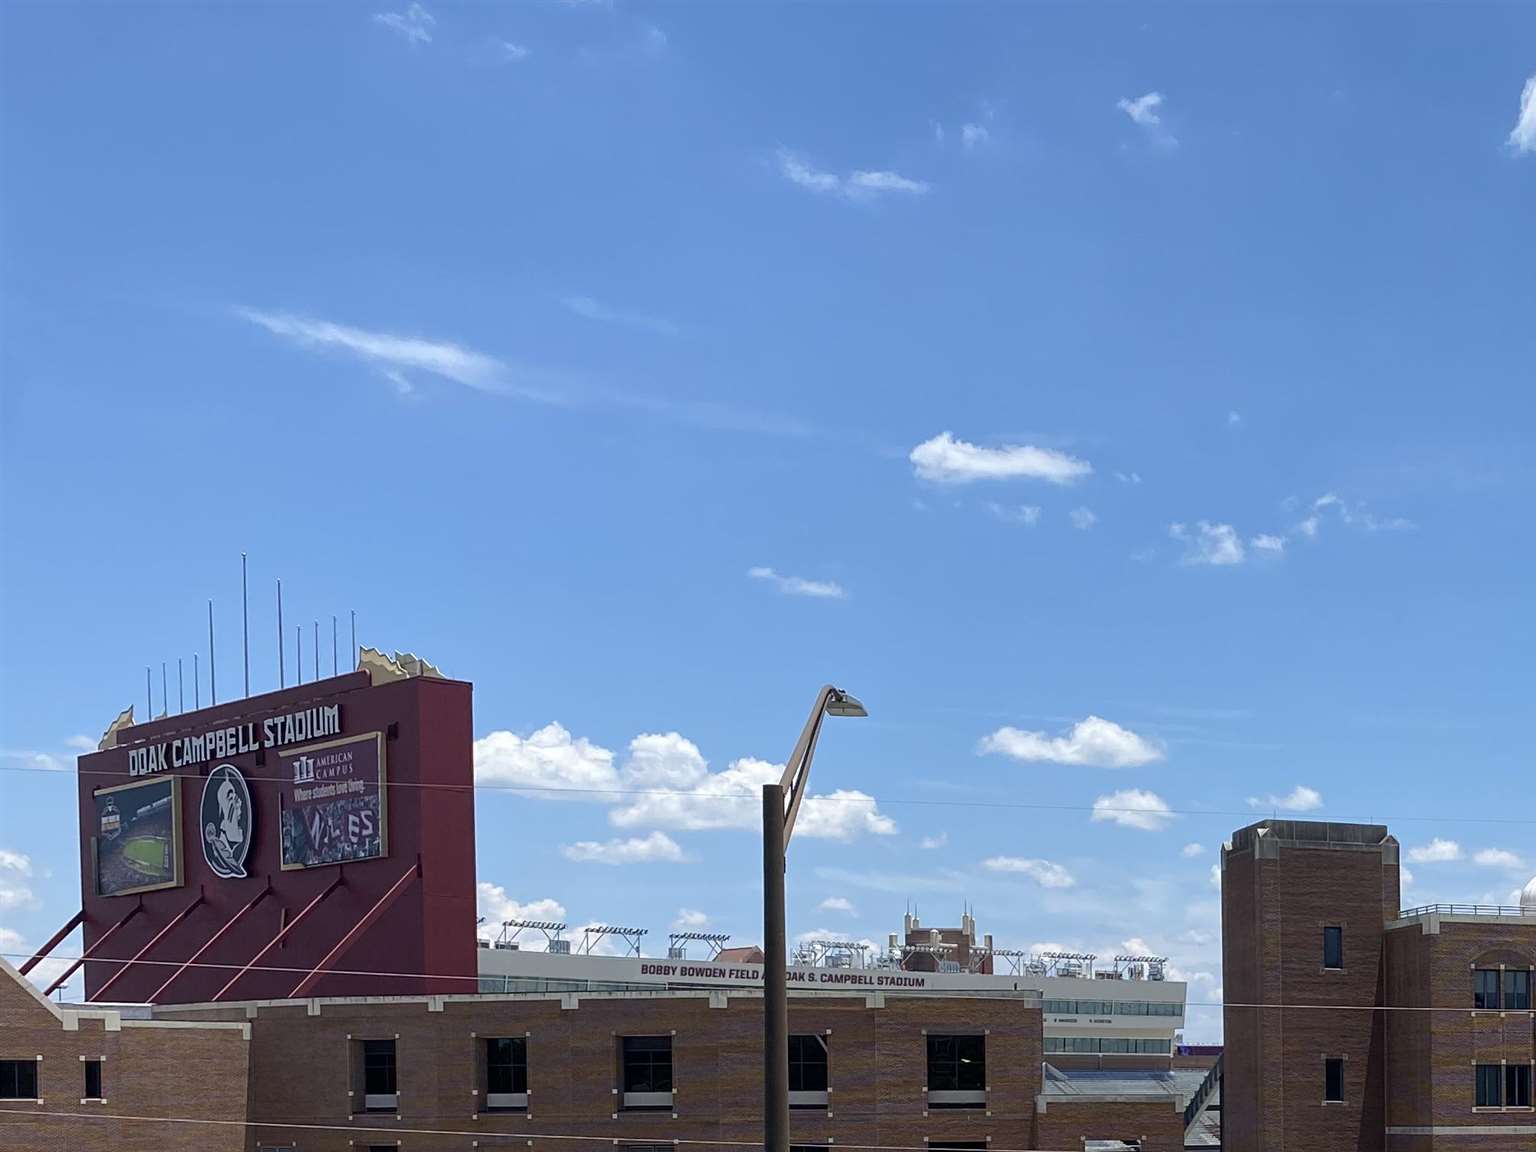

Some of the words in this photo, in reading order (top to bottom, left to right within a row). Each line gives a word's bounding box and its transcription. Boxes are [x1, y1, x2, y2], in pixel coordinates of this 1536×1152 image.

[129, 742, 168, 777] DOAK
[172, 723, 260, 767] CAMPBELL
[264, 704, 341, 748] STADIUM
[316, 752, 353, 767] AMERICAN
[315, 764, 353, 780] CAMPUS
[641, 964, 678, 976] BOBBY
[680, 966, 726, 979] BOWDEN
[728, 969, 760, 980] FIELD
[808, 972, 817, 982] S.
[820, 973, 875, 985] CAMPBELL
[877, 976, 925, 987] STADIUM
